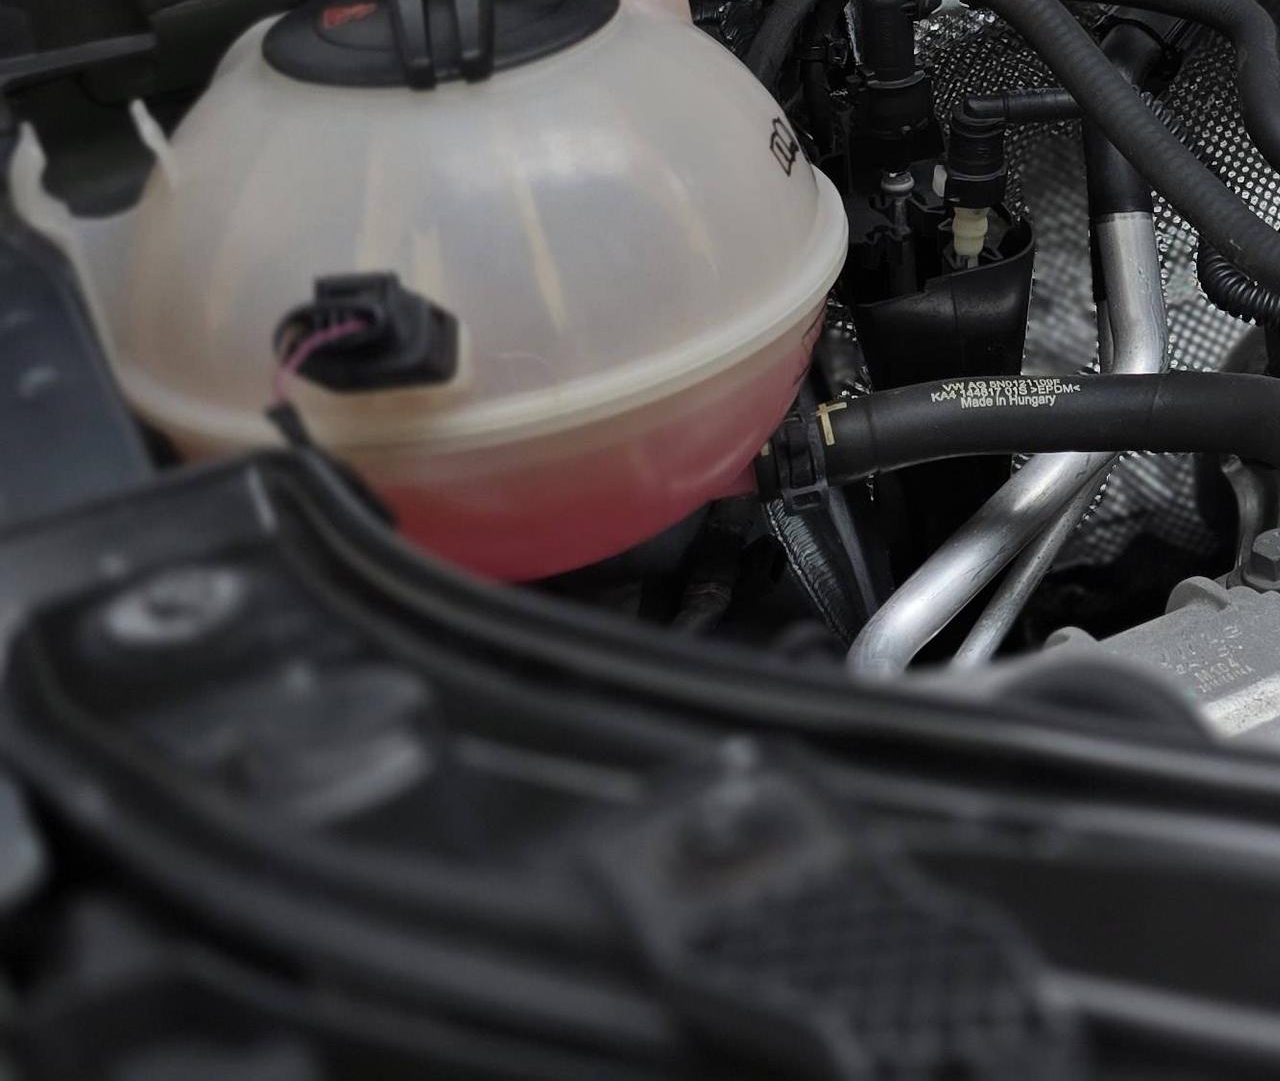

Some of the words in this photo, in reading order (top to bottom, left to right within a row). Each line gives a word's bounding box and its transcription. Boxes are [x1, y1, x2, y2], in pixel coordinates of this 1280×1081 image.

[942, 381, 965, 392] VW
[967, 381, 987, 390] AG
[960, 396, 993, 409] Made
[995, 395, 1007, 407] in
[1009, 393, 1057, 408] Hungary
